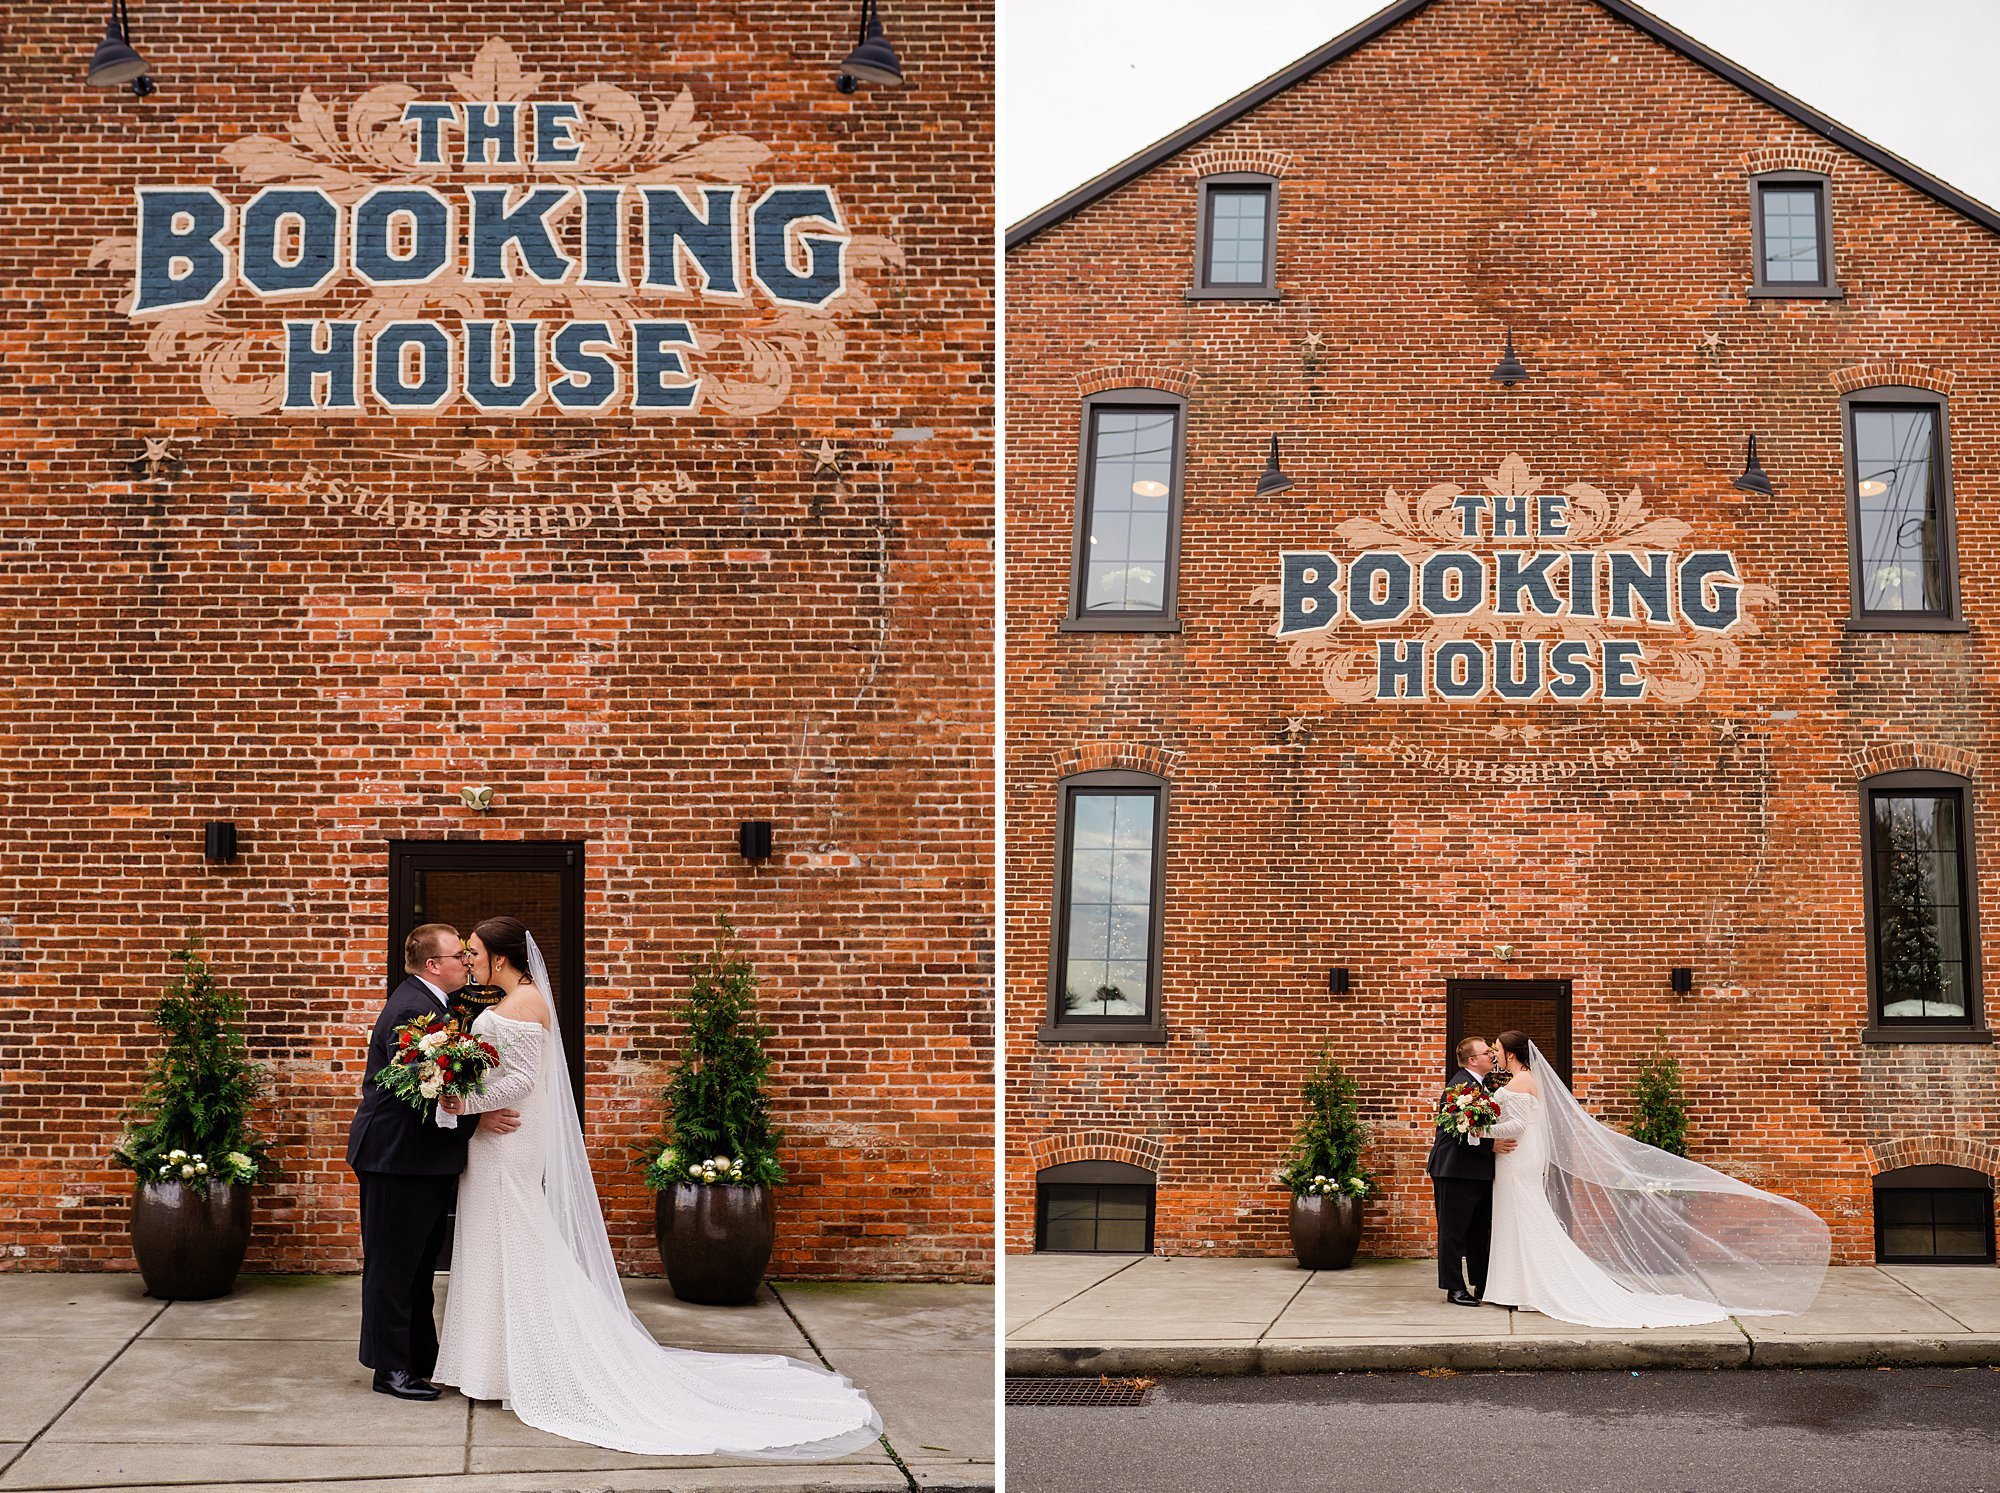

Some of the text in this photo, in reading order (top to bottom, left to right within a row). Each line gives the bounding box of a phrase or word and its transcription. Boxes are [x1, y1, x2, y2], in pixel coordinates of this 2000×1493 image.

[402, 101, 585, 166] THE
[128, 184, 852, 316] BOOKING
[281, 319, 702, 411] HOUSE
[297, 464, 697, 537] ESTABLISHED 1884
[1452, 495, 1572, 538] THE
[1276, 550, 1744, 636] BOOKING
[1375, 640, 1648, 699] HOUSE
[1386, 735, 1645, 783] ESTABLISHED 1884
